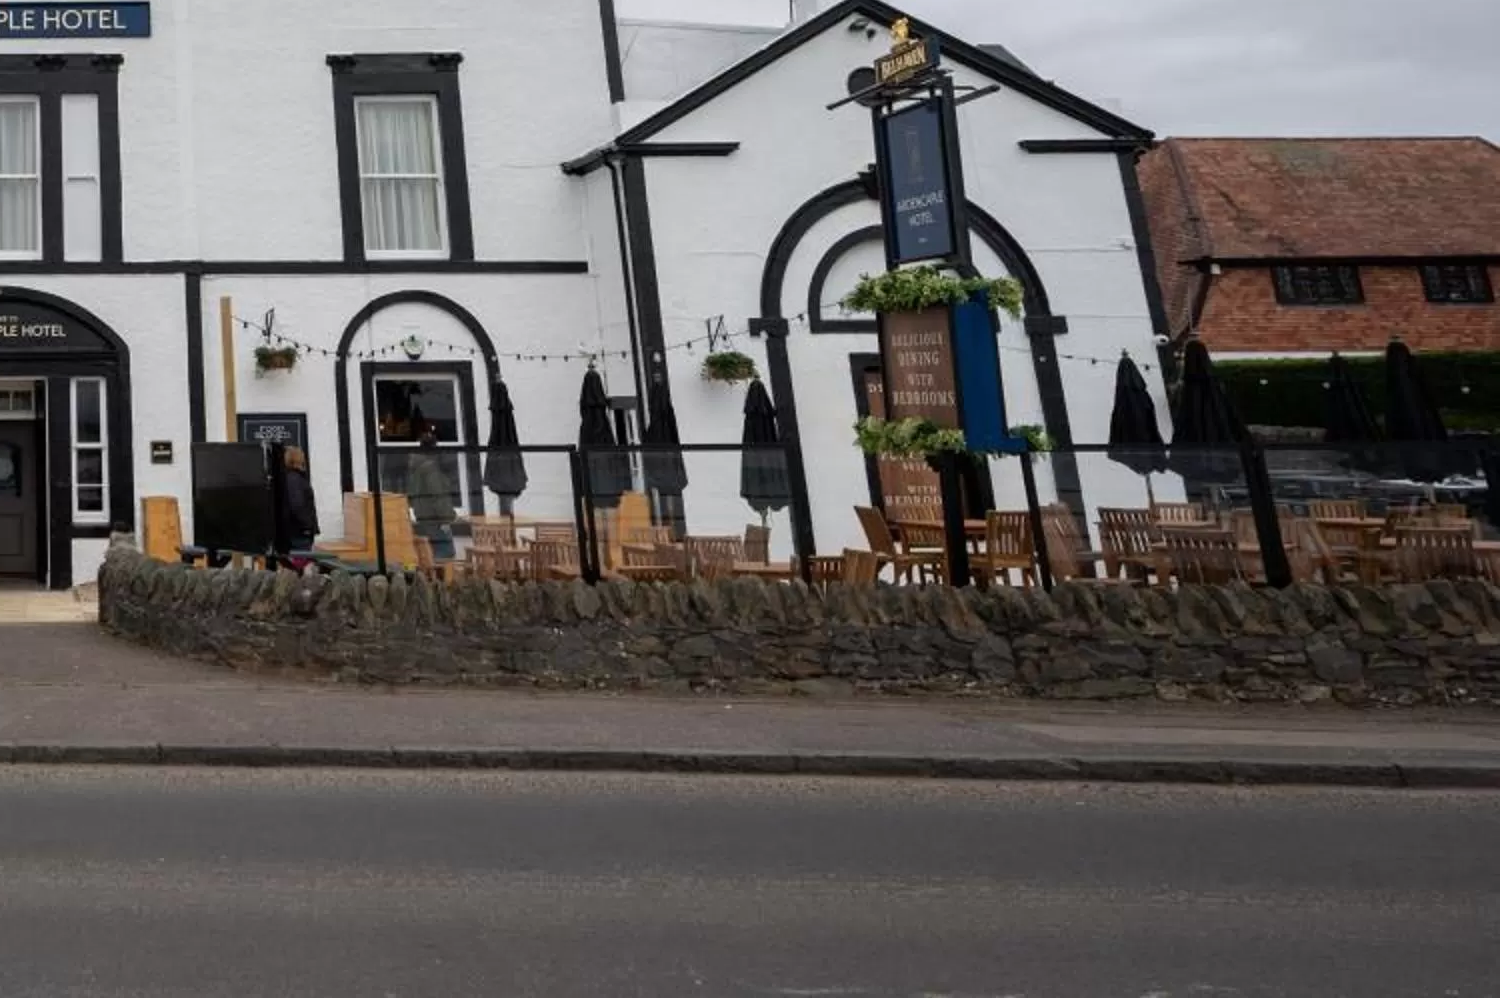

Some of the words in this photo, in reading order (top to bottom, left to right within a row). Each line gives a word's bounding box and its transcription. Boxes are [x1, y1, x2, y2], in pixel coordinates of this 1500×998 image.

[43, 8, 127, 30] HOTEL
[21, 324, 67, 337] HOTEL
[898, 350, 940, 367] DINING
